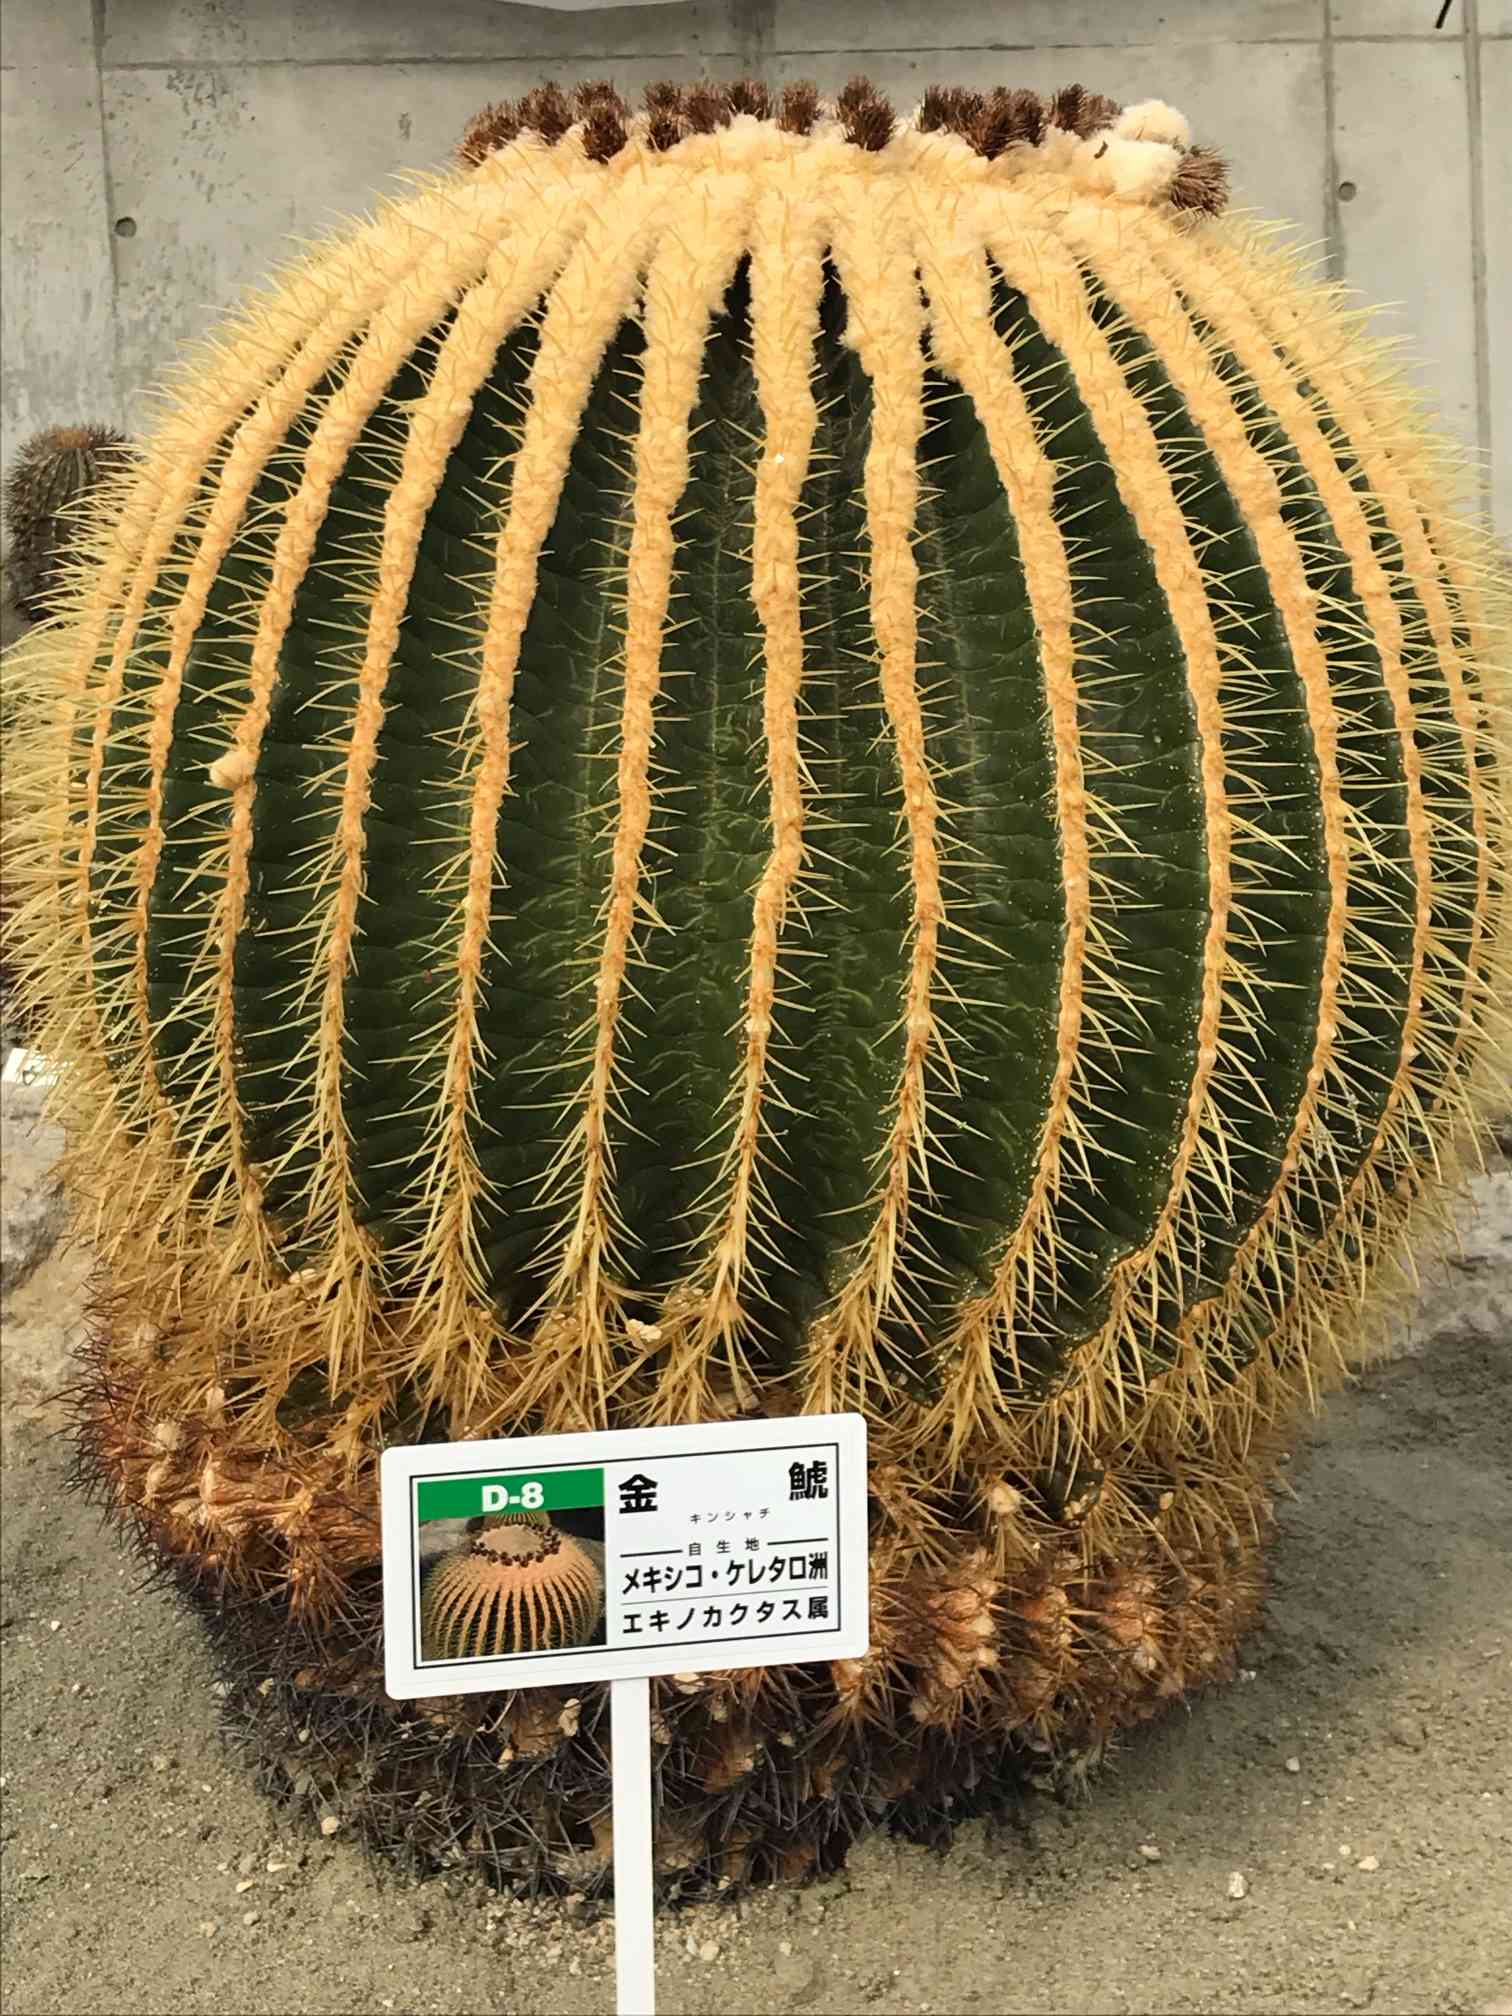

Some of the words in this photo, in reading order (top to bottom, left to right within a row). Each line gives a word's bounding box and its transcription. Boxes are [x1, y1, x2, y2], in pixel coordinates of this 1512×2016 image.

[482, 1482, 544, 1512] D-8
[690, 1507, 770, 1524] キンシャチ
[689, 1537, 760, 1556] 自生地
[622, 1552, 828, 1595] メキシコ・ケレタロ洲
[623, 1596, 829, 1634] エキノカクタス属
